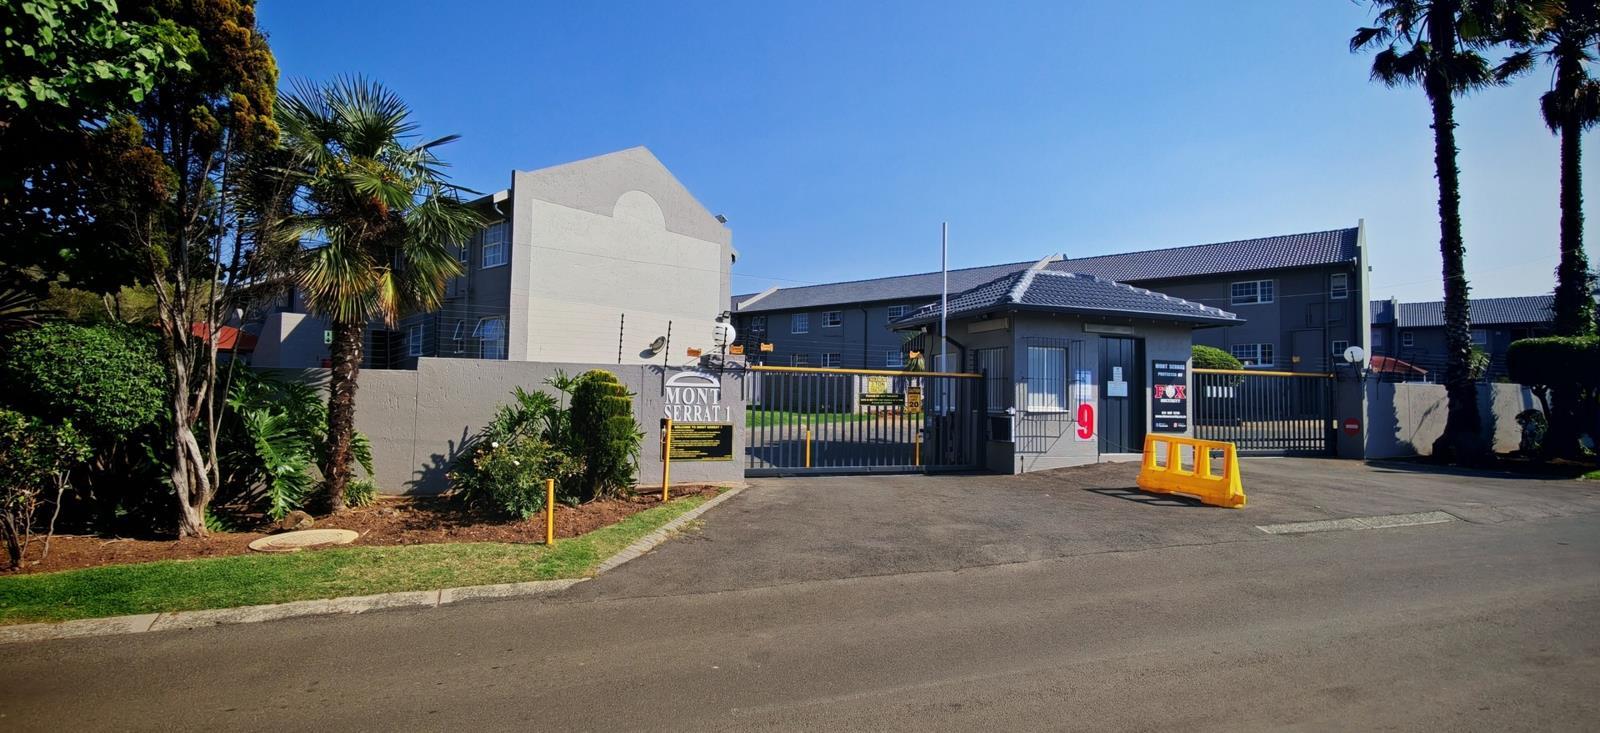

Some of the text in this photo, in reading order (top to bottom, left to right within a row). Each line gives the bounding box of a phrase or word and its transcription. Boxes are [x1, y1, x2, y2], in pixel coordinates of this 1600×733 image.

[665, 387, 720, 404] MONT
[664, 405, 730, 421] SERRAT 1
[1077, 403, 1094, 439] 9
